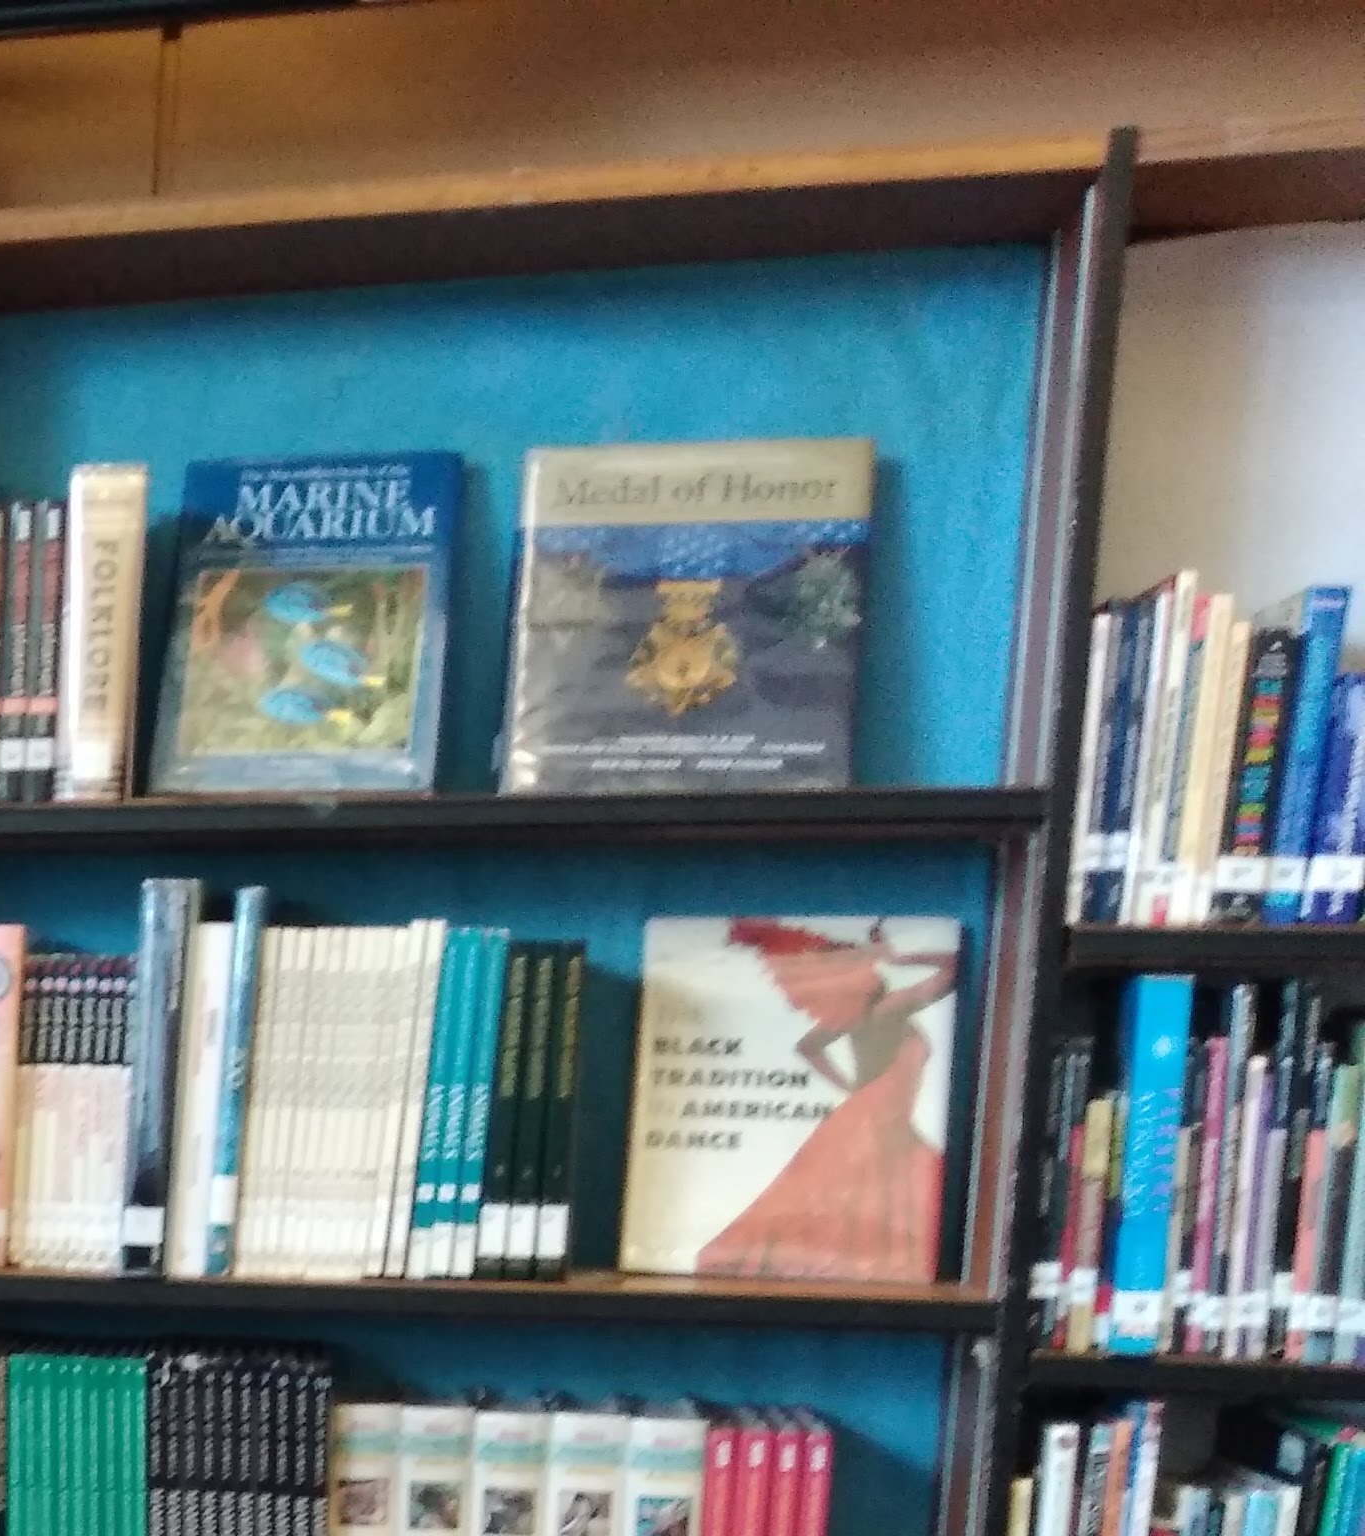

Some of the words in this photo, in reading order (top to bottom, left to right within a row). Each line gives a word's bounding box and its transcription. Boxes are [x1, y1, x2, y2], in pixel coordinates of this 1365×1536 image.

[237, 479, 411, 511] MARINE
[557, 474, 661, 506] Medal
[672, 472, 709, 503] of
[723, 471, 838, 503] Honor
[202, 506, 437, 548] AQUARIUM
[82, 537, 118, 712] FOLKLORE
[652, 1035, 743, 1057] BLACK
[650, 1067, 810, 1088] TRADITION
[680, 1099, 835, 1120] AMERICAN
[644, 1129, 744, 1150] DANCE
